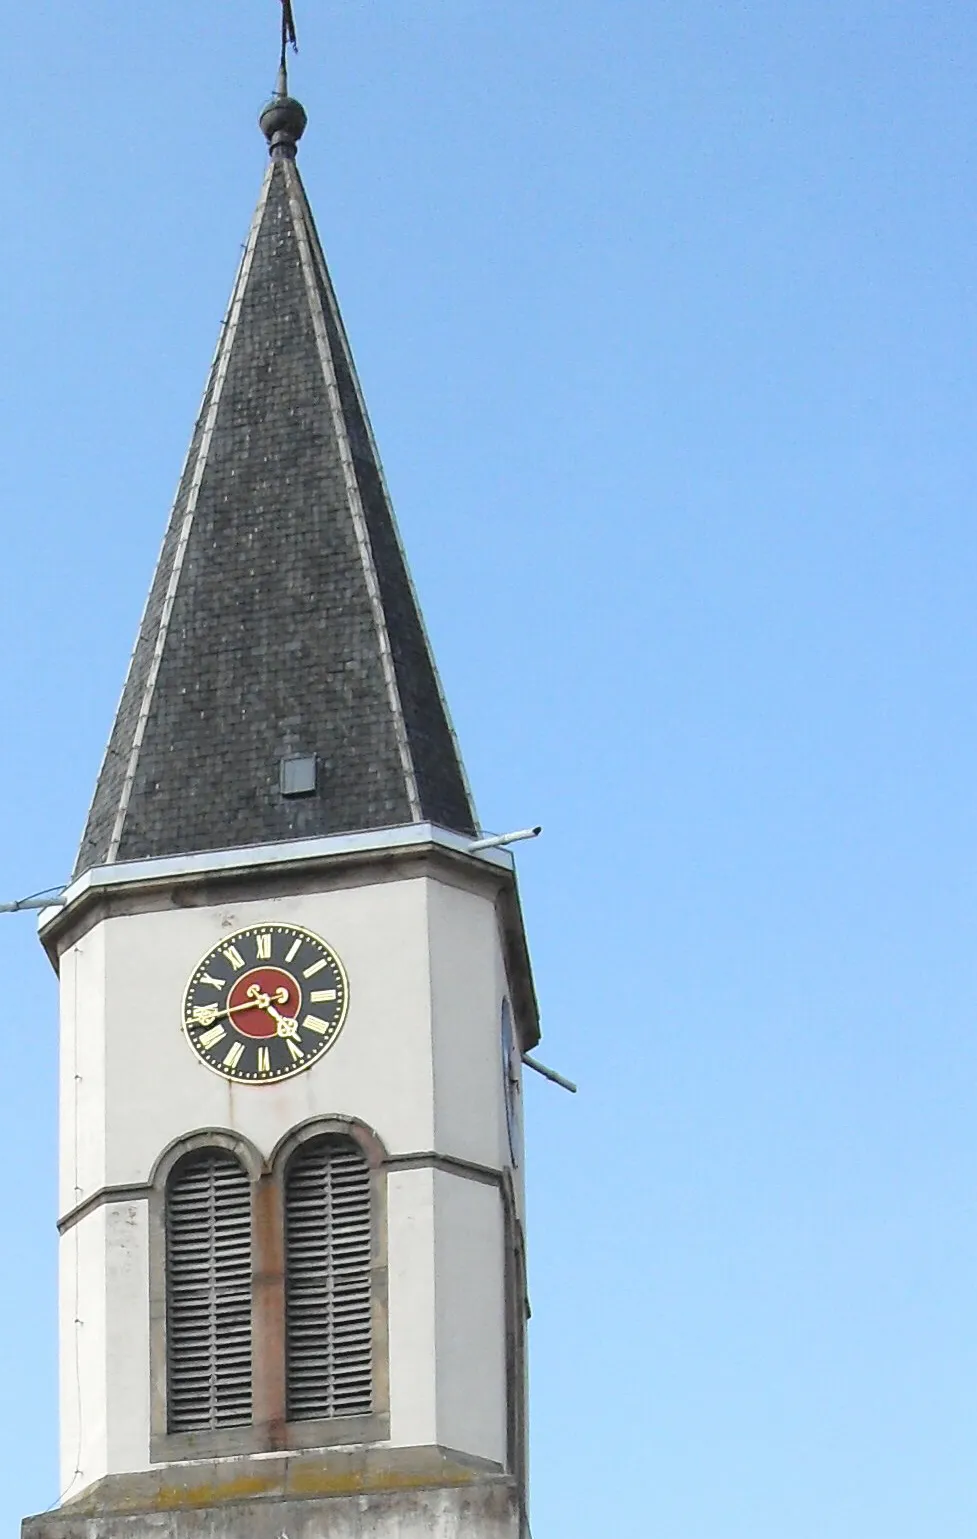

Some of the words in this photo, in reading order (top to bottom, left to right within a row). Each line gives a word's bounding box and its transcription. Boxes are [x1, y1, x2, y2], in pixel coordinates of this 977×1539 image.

[256, 934, 272, 958] XII
[285, 939, 302, 962] I
[223, 946, 245, 970] XI
[200, 973, 226, 990] X
[311, 989, 336, 1002] III
[302, 1015, 329, 1034] IIII
[223, 1042, 245, 1068] VII
[258, 1047, 270, 1071] VI
[286, 1039, 304, 1061] V
